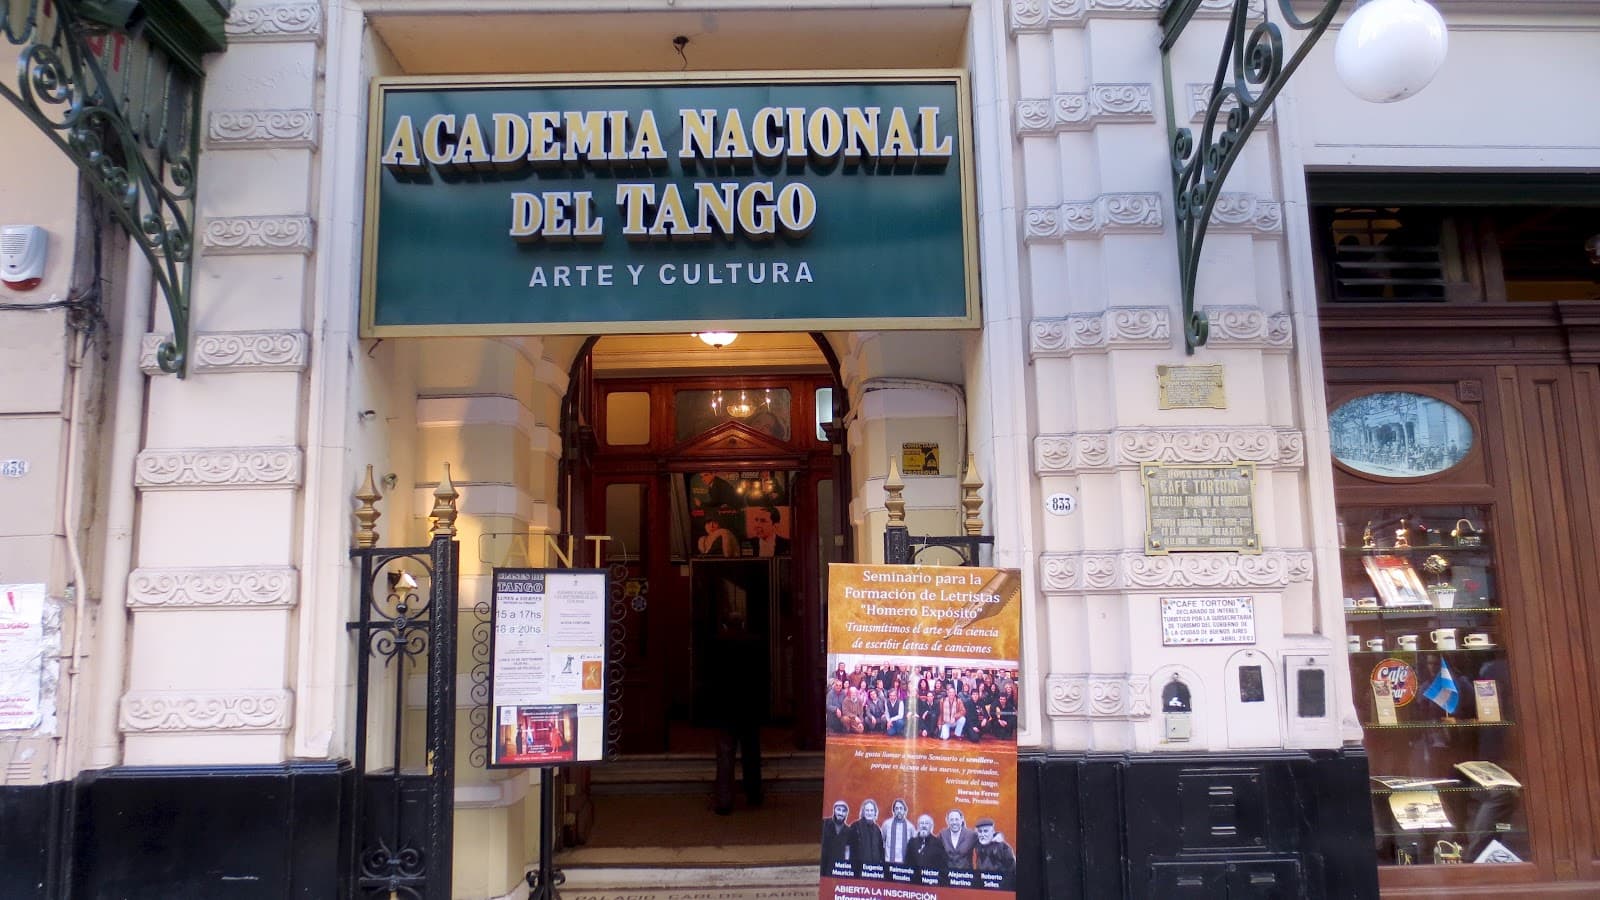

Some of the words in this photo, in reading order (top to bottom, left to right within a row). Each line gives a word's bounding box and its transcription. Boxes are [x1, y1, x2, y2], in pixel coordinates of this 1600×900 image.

[382, 110, 667, 168] ACADEMIA
[679, 106, 953, 163] NACIONAL
[509, 190, 604, 238] DEL
[616, 182, 817, 237] TANGO
[529, 265, 614, 288] ARTE
[628, 264, 646, 286] Y
[659, 262, 814, 286] CULTURA
[1052, 497, 1071, 511] 833
[497, 581, 544, 592] TANGO
[863, 570, 931, 582] Seminario
[936, 575, 966, 587] para
[970, 574, 982, 584] la
[845, 586, 916, 600] Formación
[920, 590, 937, 600] de
[941, 590, 1001, 604] Letristas
[520, 610, 542, 619] 17hs
[861, 604, 918, 616] "Homero
[922, 605, 983, 620] Expósito"
[846, 622, 911, 634] Transmitimos
[912, 623, 922, 634] el
[923, 626, 943, 635] arte
[966, 627, 999, 638] ciencia
[852, 638, 864, 648] de
[865, 640, 902, 650] escribir
[931, 640, 943, 651] de
[945, 643, 992, 654] canciones
[1377, 666, 1409, 686] Café
[948, 871, 974, 880] Alejandro
[834, 885, 870, 894] ABIERTA
[871, 887, 882, 896] LA
[883, 888, 938, 900] INSCRIPCIÓN
